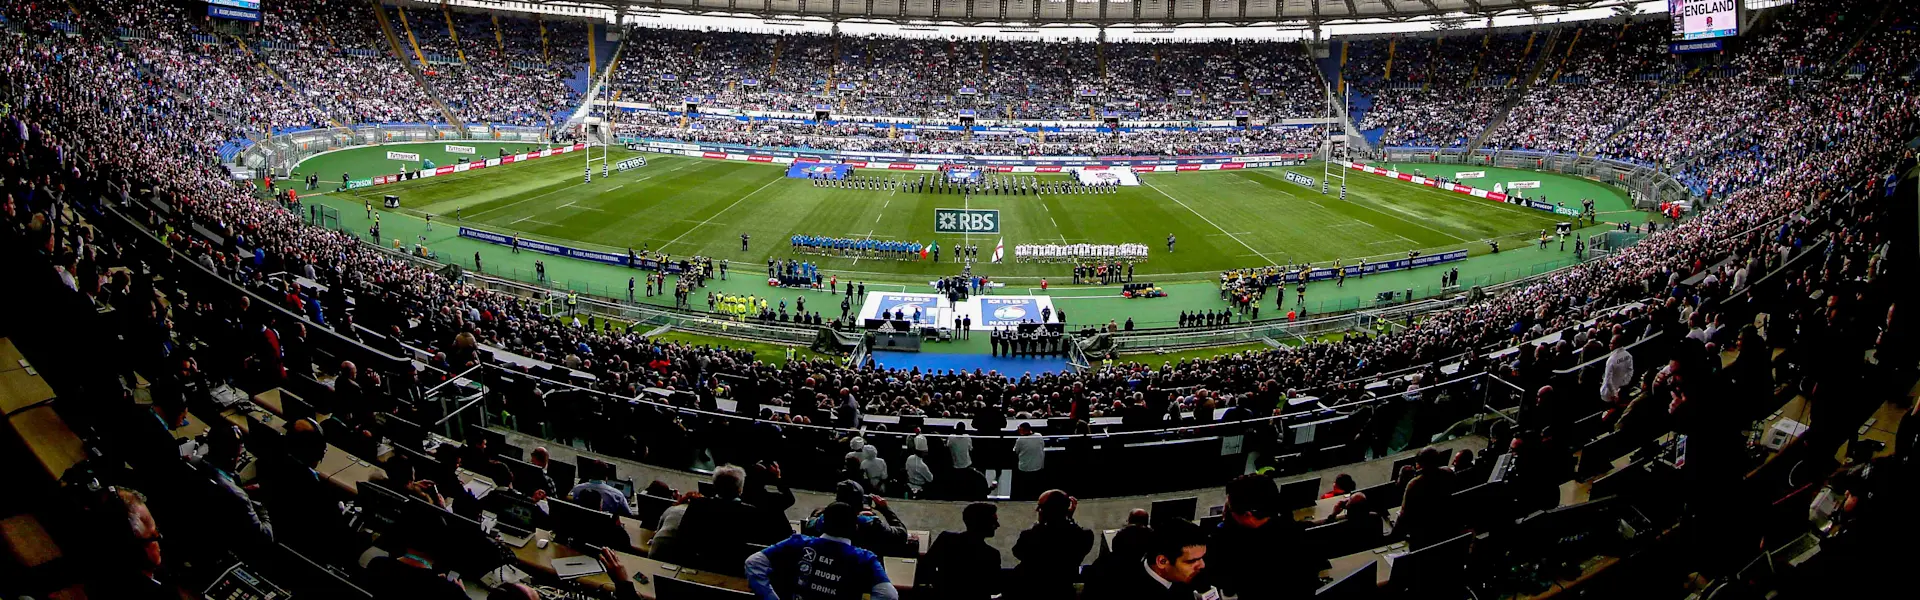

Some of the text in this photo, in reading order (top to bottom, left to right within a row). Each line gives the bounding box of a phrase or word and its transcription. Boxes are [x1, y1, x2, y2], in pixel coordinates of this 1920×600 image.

[1685, 1, 1734, 17] ENGLAND
[628, 157, 645, 169] RBS
[1294, 175, 1313, 187] RBS
[960, 213, 994, 230] RBS
[819, 555, 834, 565] EAT
[815, 569, 841, 582] RUGBY
[811, 583, 837, 595] DRINK
